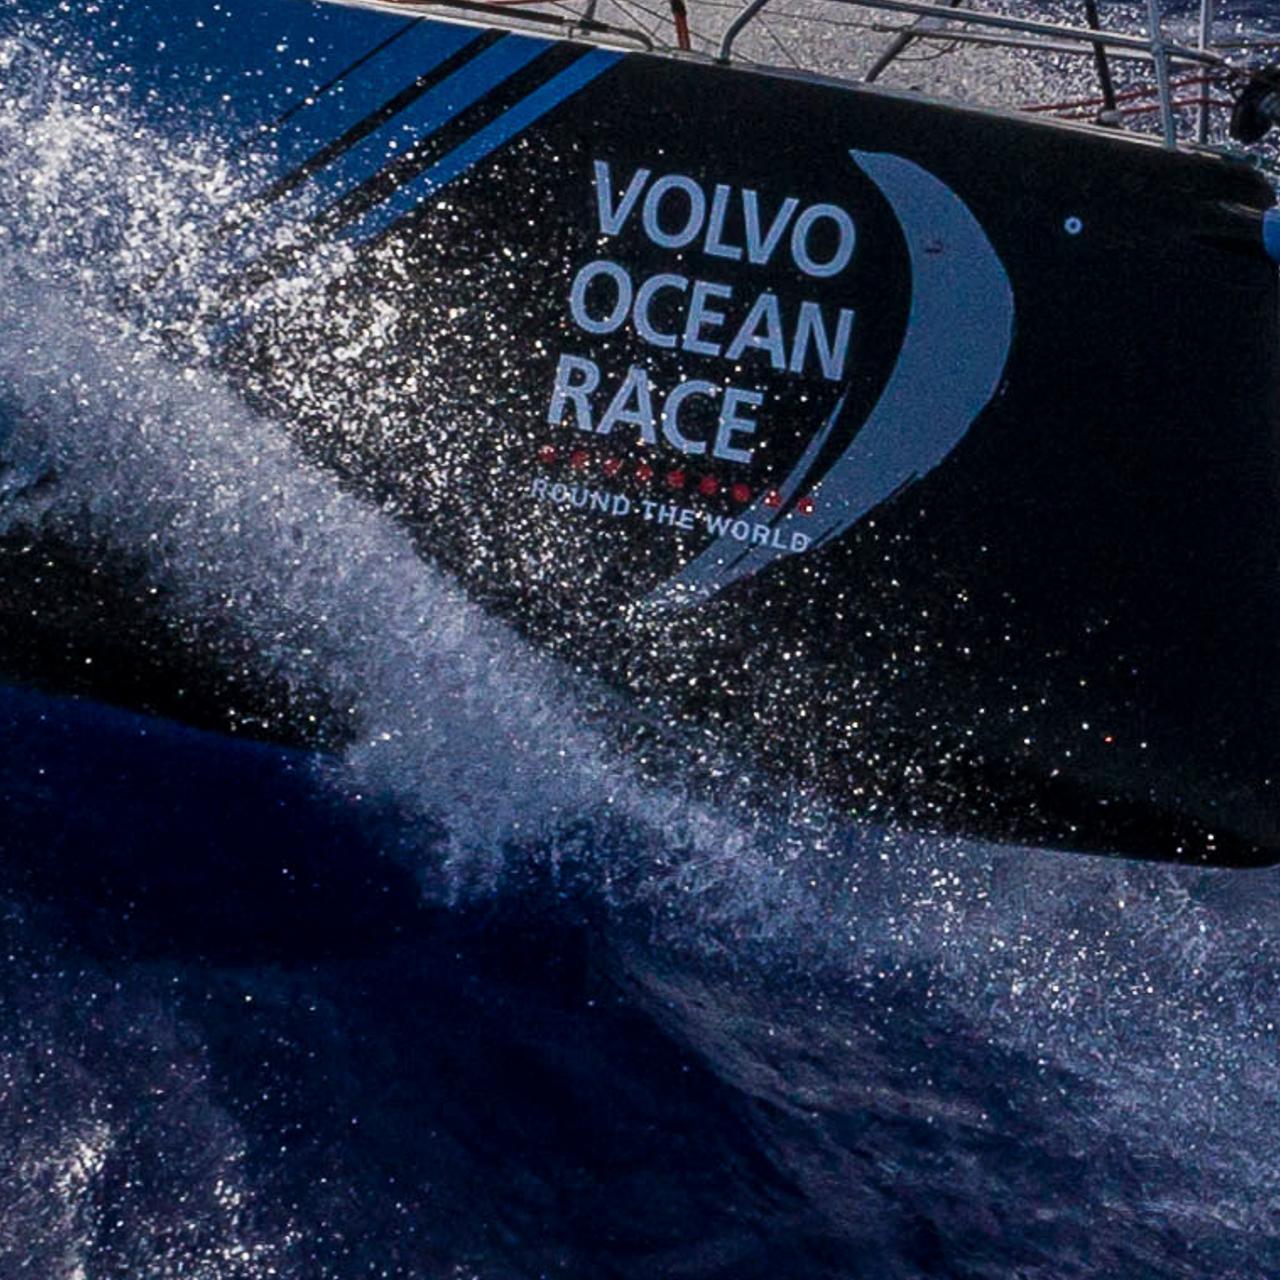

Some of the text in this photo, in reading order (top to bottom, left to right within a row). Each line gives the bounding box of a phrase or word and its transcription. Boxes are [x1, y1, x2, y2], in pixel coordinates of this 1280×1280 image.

[593, 159, 857, 278] VOLVO
[569, 259, 856, 381] OCEAN
[546, 353, 764, 464] RACE
[530, 478, 811, 553] ROUND THE WORLD
